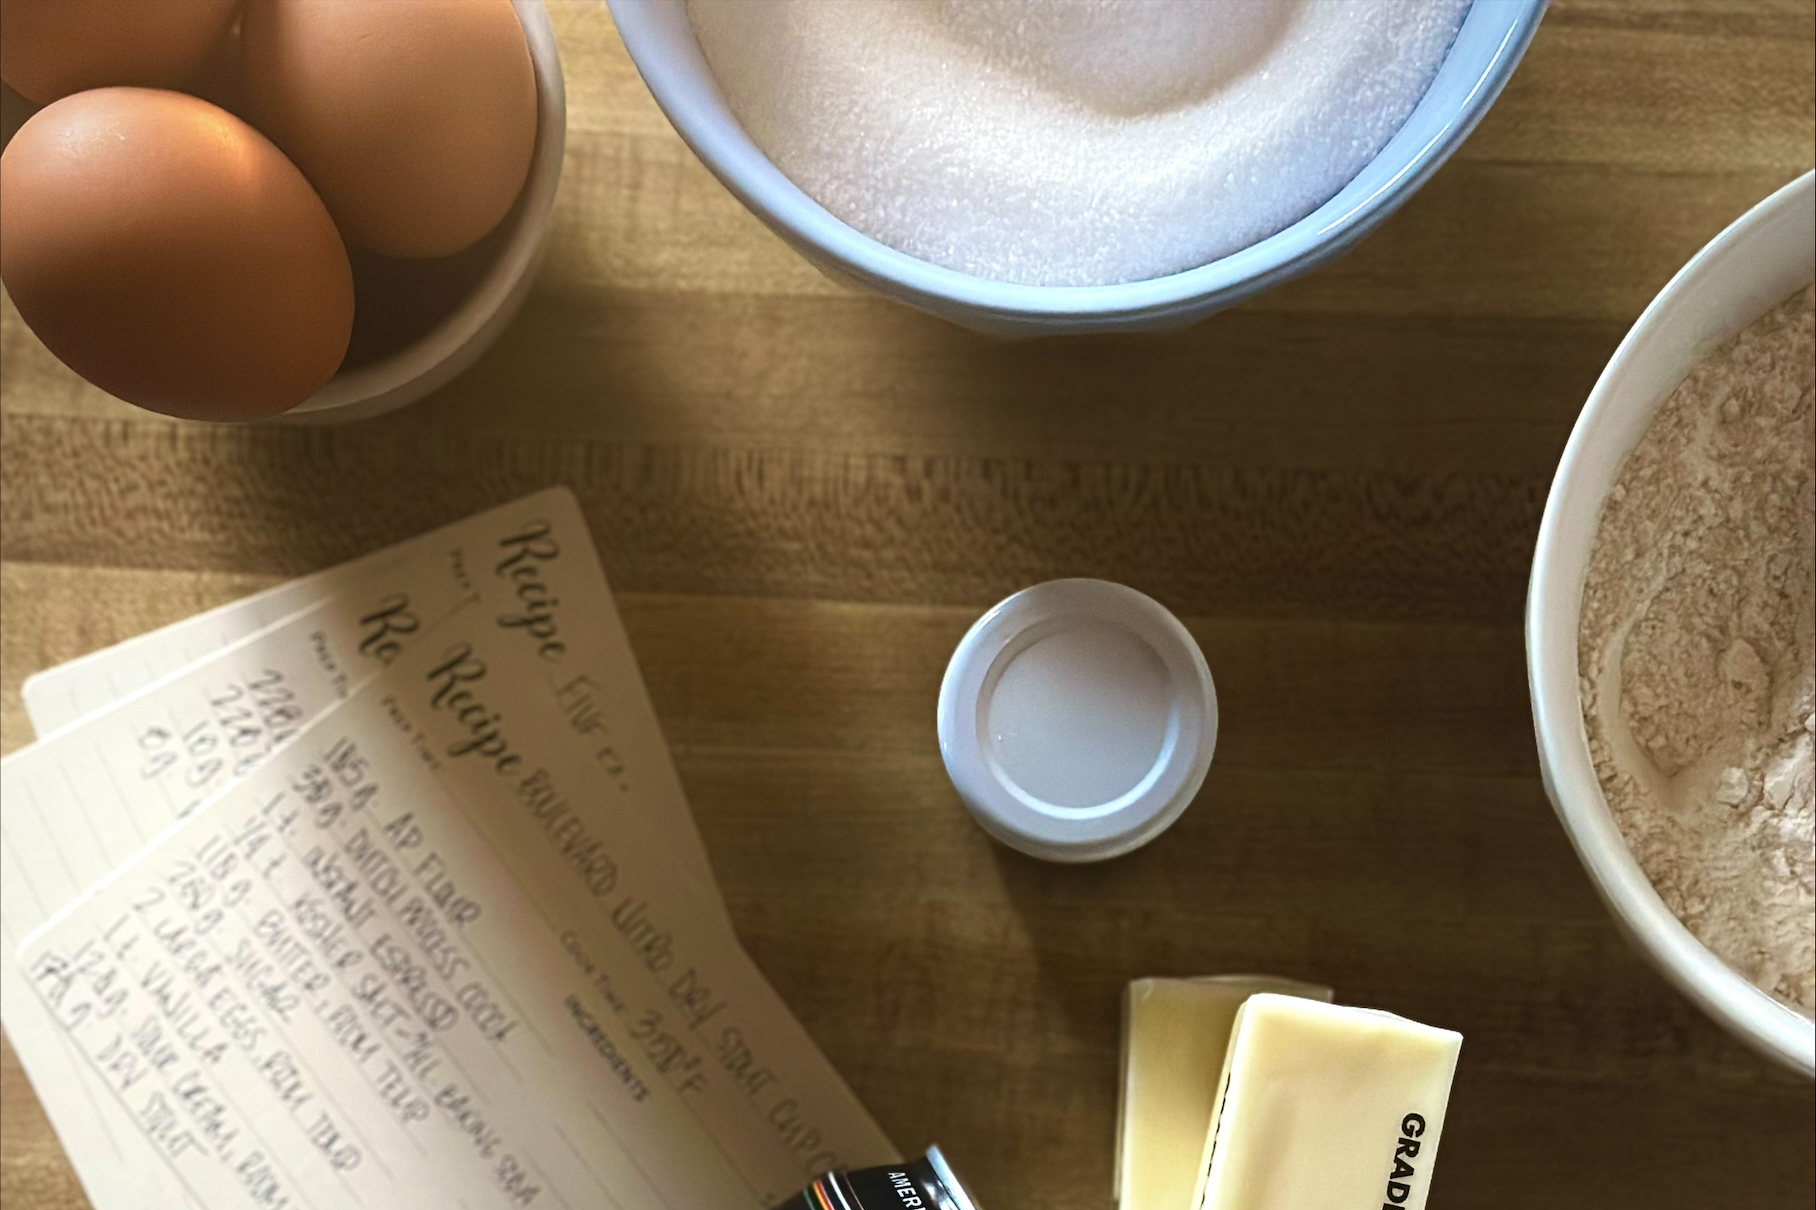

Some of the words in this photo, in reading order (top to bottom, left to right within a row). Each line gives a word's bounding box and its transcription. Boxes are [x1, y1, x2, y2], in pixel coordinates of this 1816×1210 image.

[494, 519, 567, 662] Recipe
[424, 644, 522, 774] Recipe
[381, 812, 422, 850] AP
[516, 767, 618, 898] BOULEVARD
[562, 994, 650, 1103] INGREDIENTS
